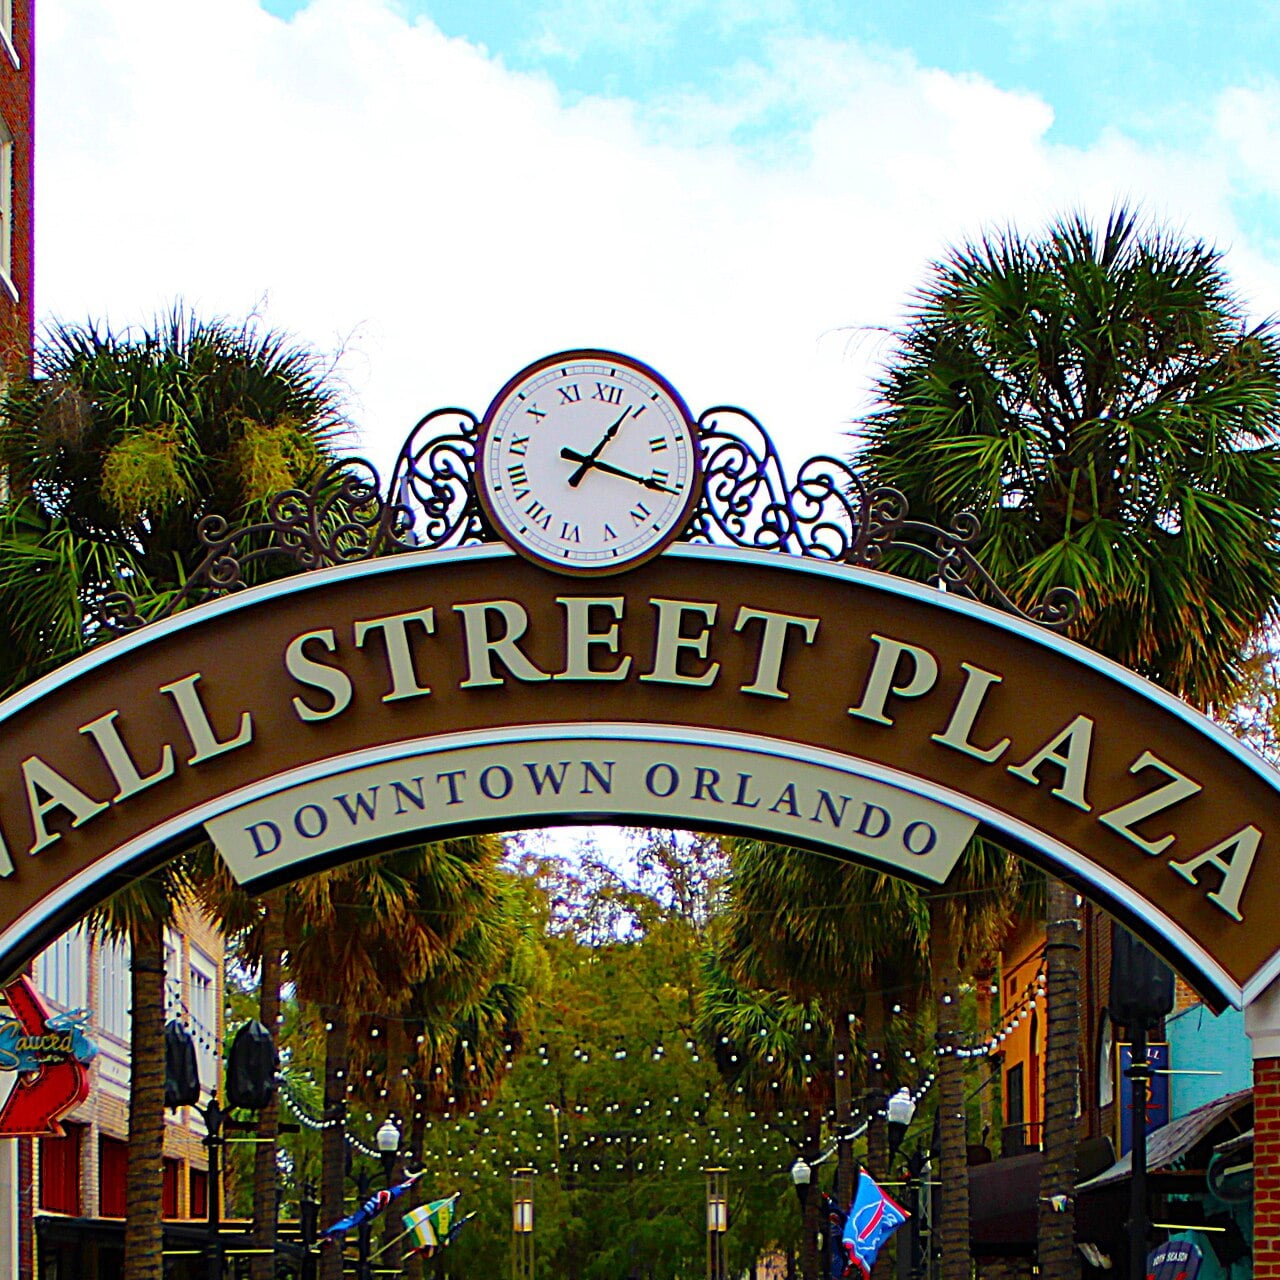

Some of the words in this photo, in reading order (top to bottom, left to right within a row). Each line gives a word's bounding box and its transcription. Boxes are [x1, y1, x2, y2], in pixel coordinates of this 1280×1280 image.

[557, 383, 582, 405] XI
[592, 382, 623, 405] XII
[527, 403, 547, 424] X
[508, 432, 530, 457] IX
[649, 436, 668, 453] II
[507, 464, 531, 501] VIII
[524, 500, 553, 531] VII
[629, 501, 652, 528] IV
[559, 522, 581, 543] VI
[602, 523, 618, 542] V
[284, 596, 820, 722] STREET
[848, 634, 1263, 922] PLAZA
[243, 759, 617, 859] DOWNTOWN
[645, 761, 939, 857] ORLANDO
